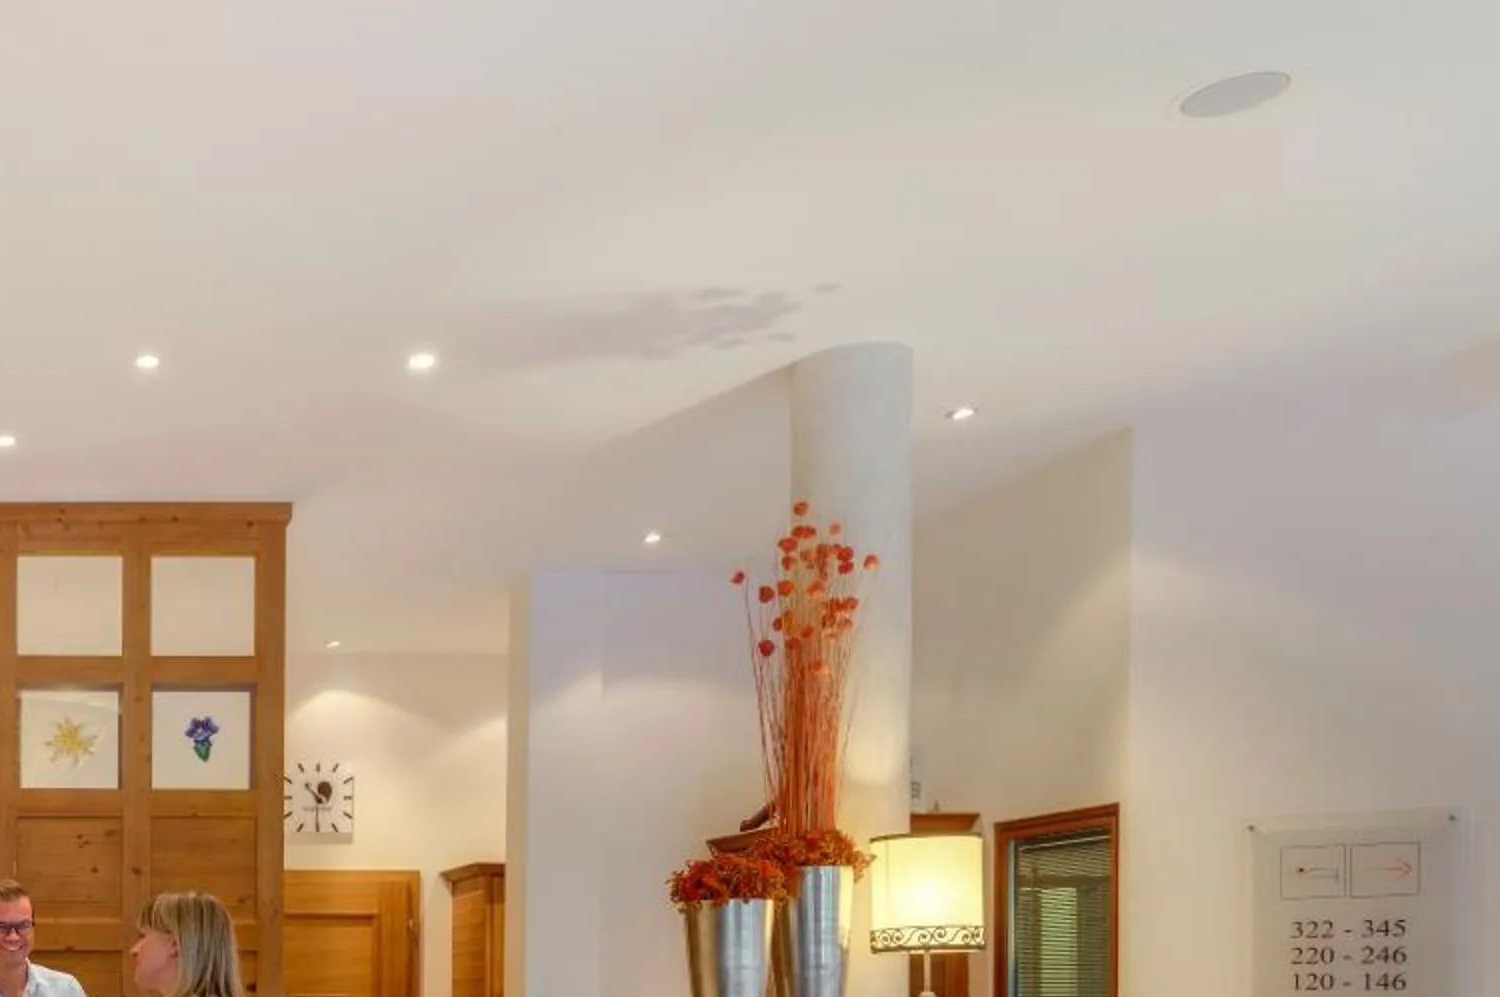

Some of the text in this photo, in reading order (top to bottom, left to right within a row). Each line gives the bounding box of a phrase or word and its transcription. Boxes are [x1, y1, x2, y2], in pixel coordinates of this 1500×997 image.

[1290, 920, 1335, 940] 322
[1361, 918, 1408, 939] 345
[1290, 946, 1336, 966] 220
[1360, 945, 1408, 966] 246
[1292, 972, 1336, 992] 120
[1362, 971, 1408, 992] 146
